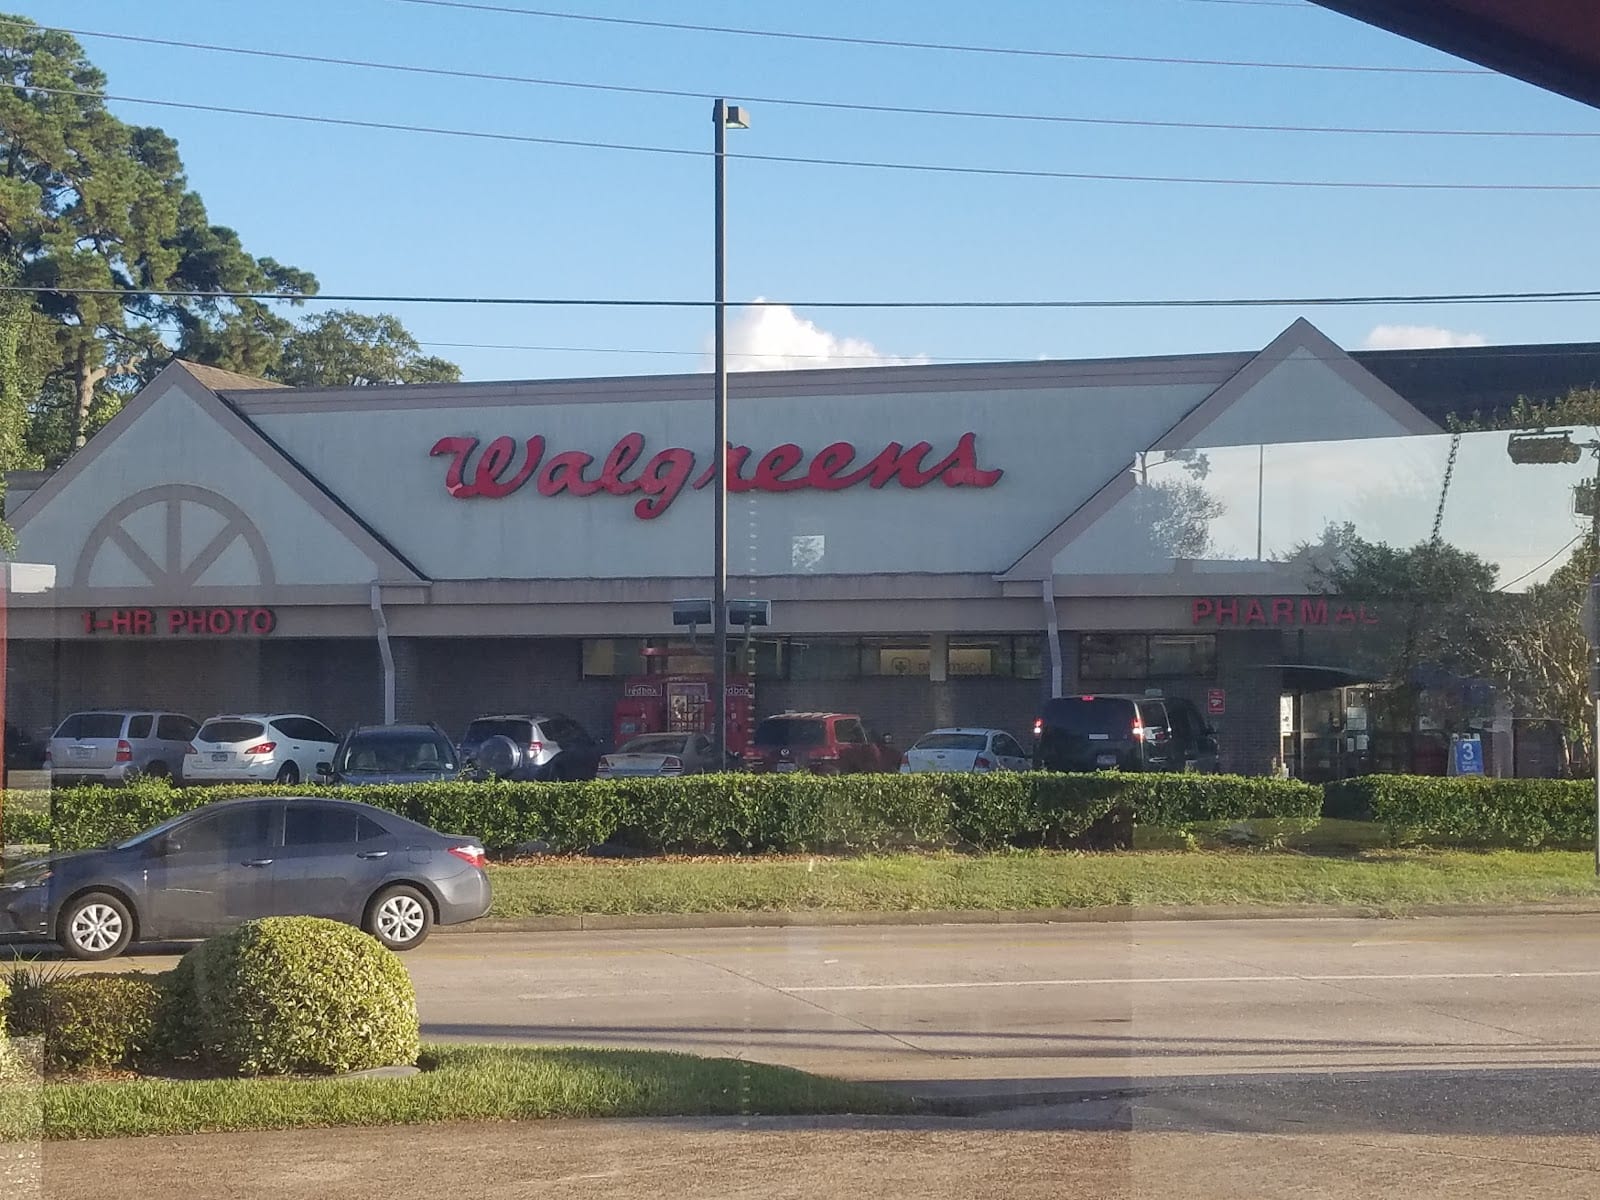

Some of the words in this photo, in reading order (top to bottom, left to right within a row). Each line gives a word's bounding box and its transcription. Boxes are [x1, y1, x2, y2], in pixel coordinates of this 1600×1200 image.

[430, 432, 1004, 519] Walgreens
[82, 608, 152, 634] 1-HR
[167, 608, 275, 634] PHOTO
[1192, 597, 1380, 625] PHARMAC
[628, 686, 657, 695] redbox
[1462, 742, 1474, 760] 3
